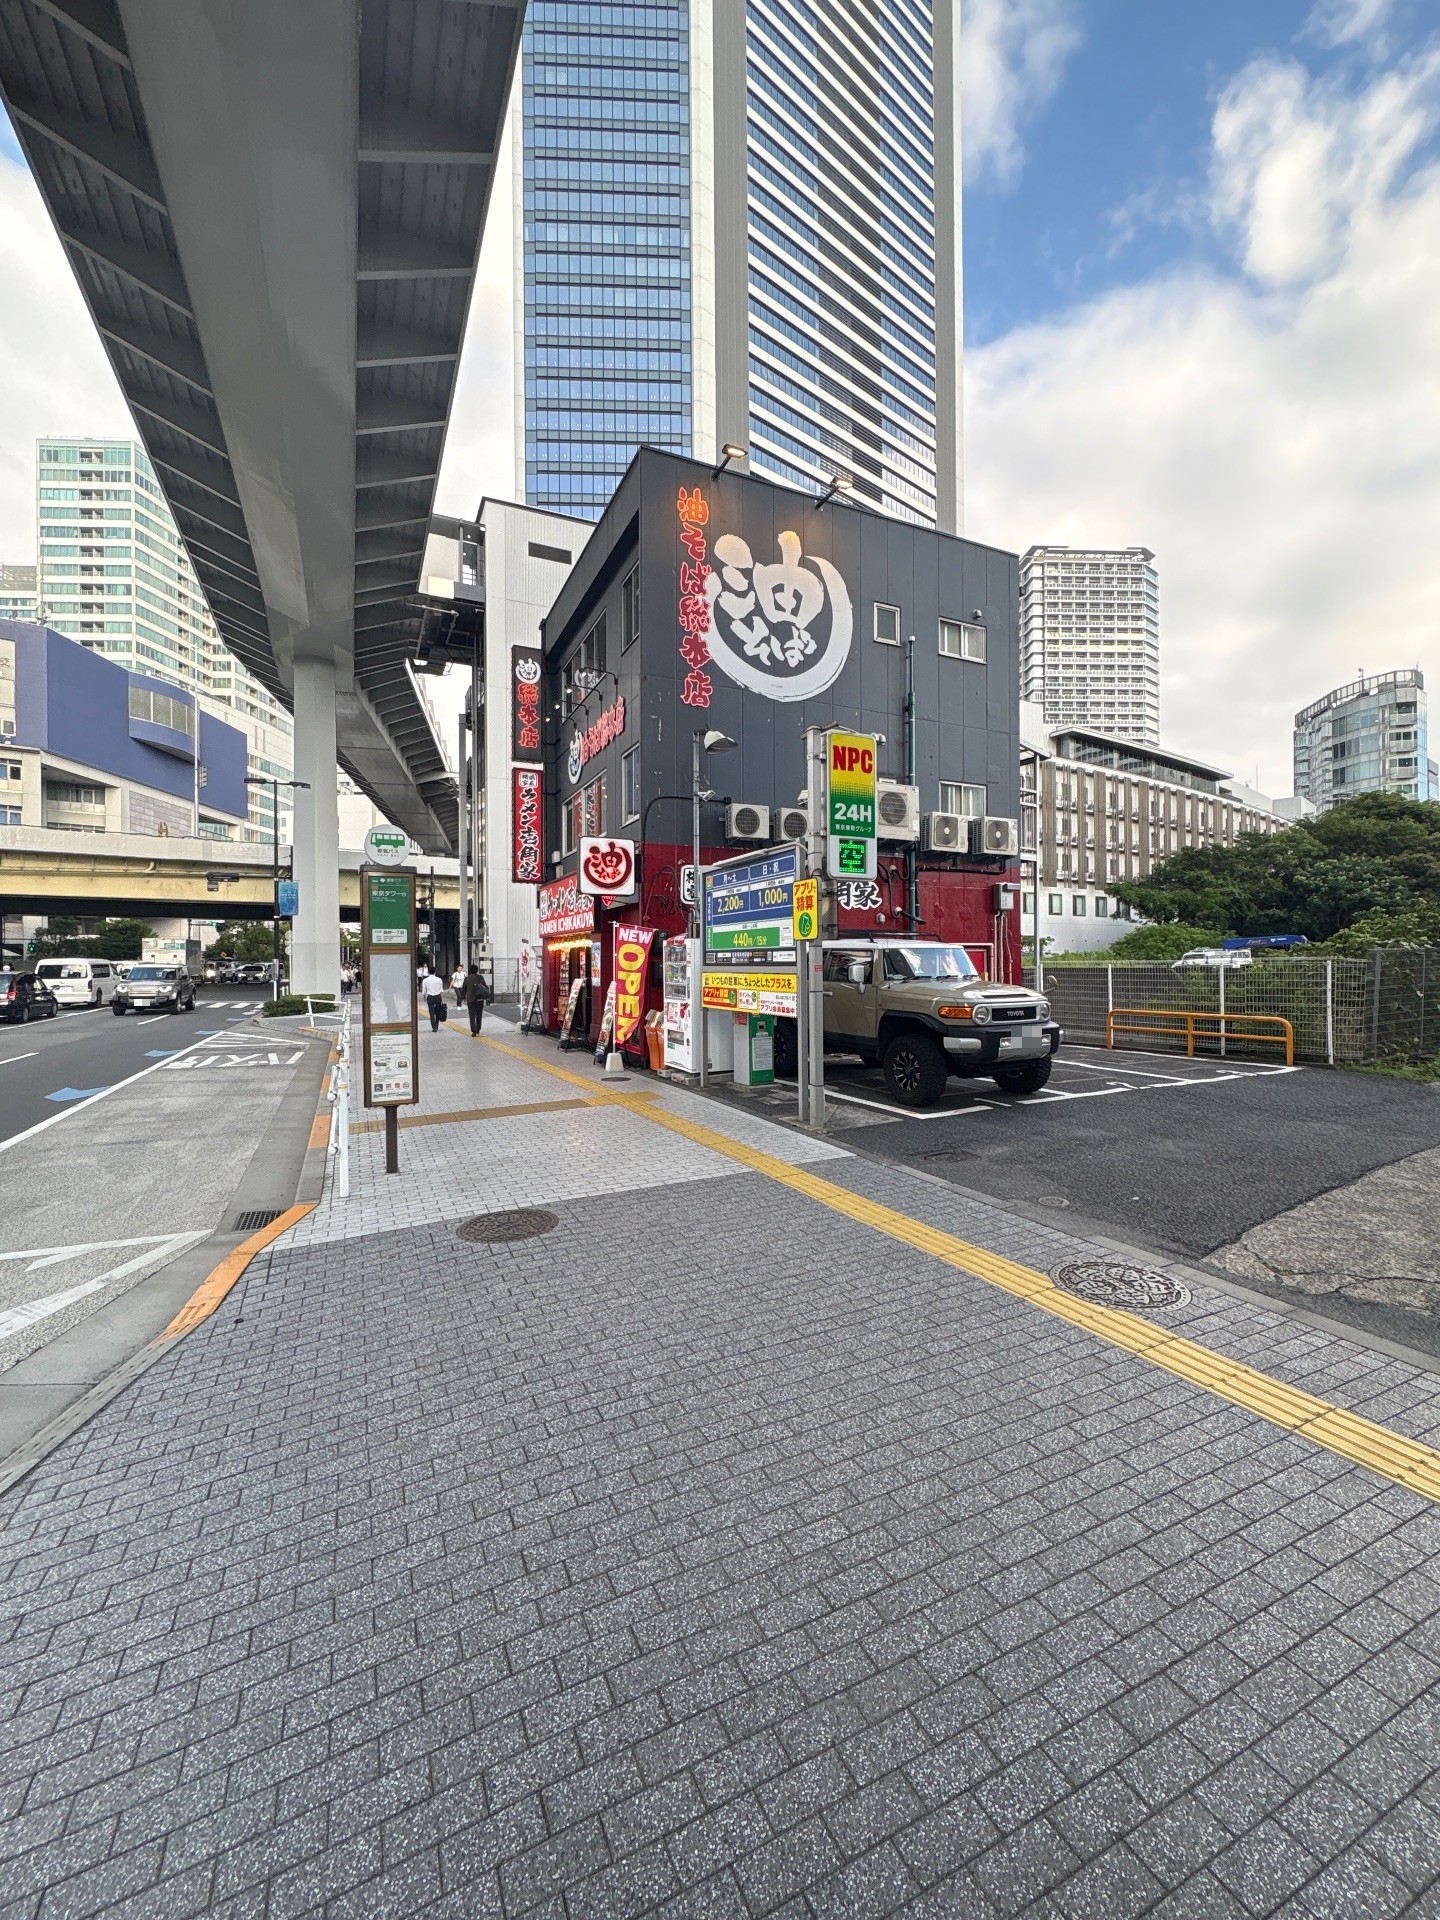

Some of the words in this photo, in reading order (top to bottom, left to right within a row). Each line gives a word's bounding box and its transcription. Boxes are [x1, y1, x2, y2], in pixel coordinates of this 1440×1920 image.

[677, 486, 713, 708] 油そば総本店
[832, 744, 873, 775] NPC
[834, 802, 873, 823] 24H
[518, 787, 541, 880] ラーメン壱角家
[758, 888, 788, 907] 1,000円
[796, 895, 814, 911] 精算
[540, 919, 557, 935] RAMEN
[558, 910, 594, 931] ICHIKAKUYA
[618, 927, 653, 944] NEW
[616, 943, 646, 1042] OPEN
